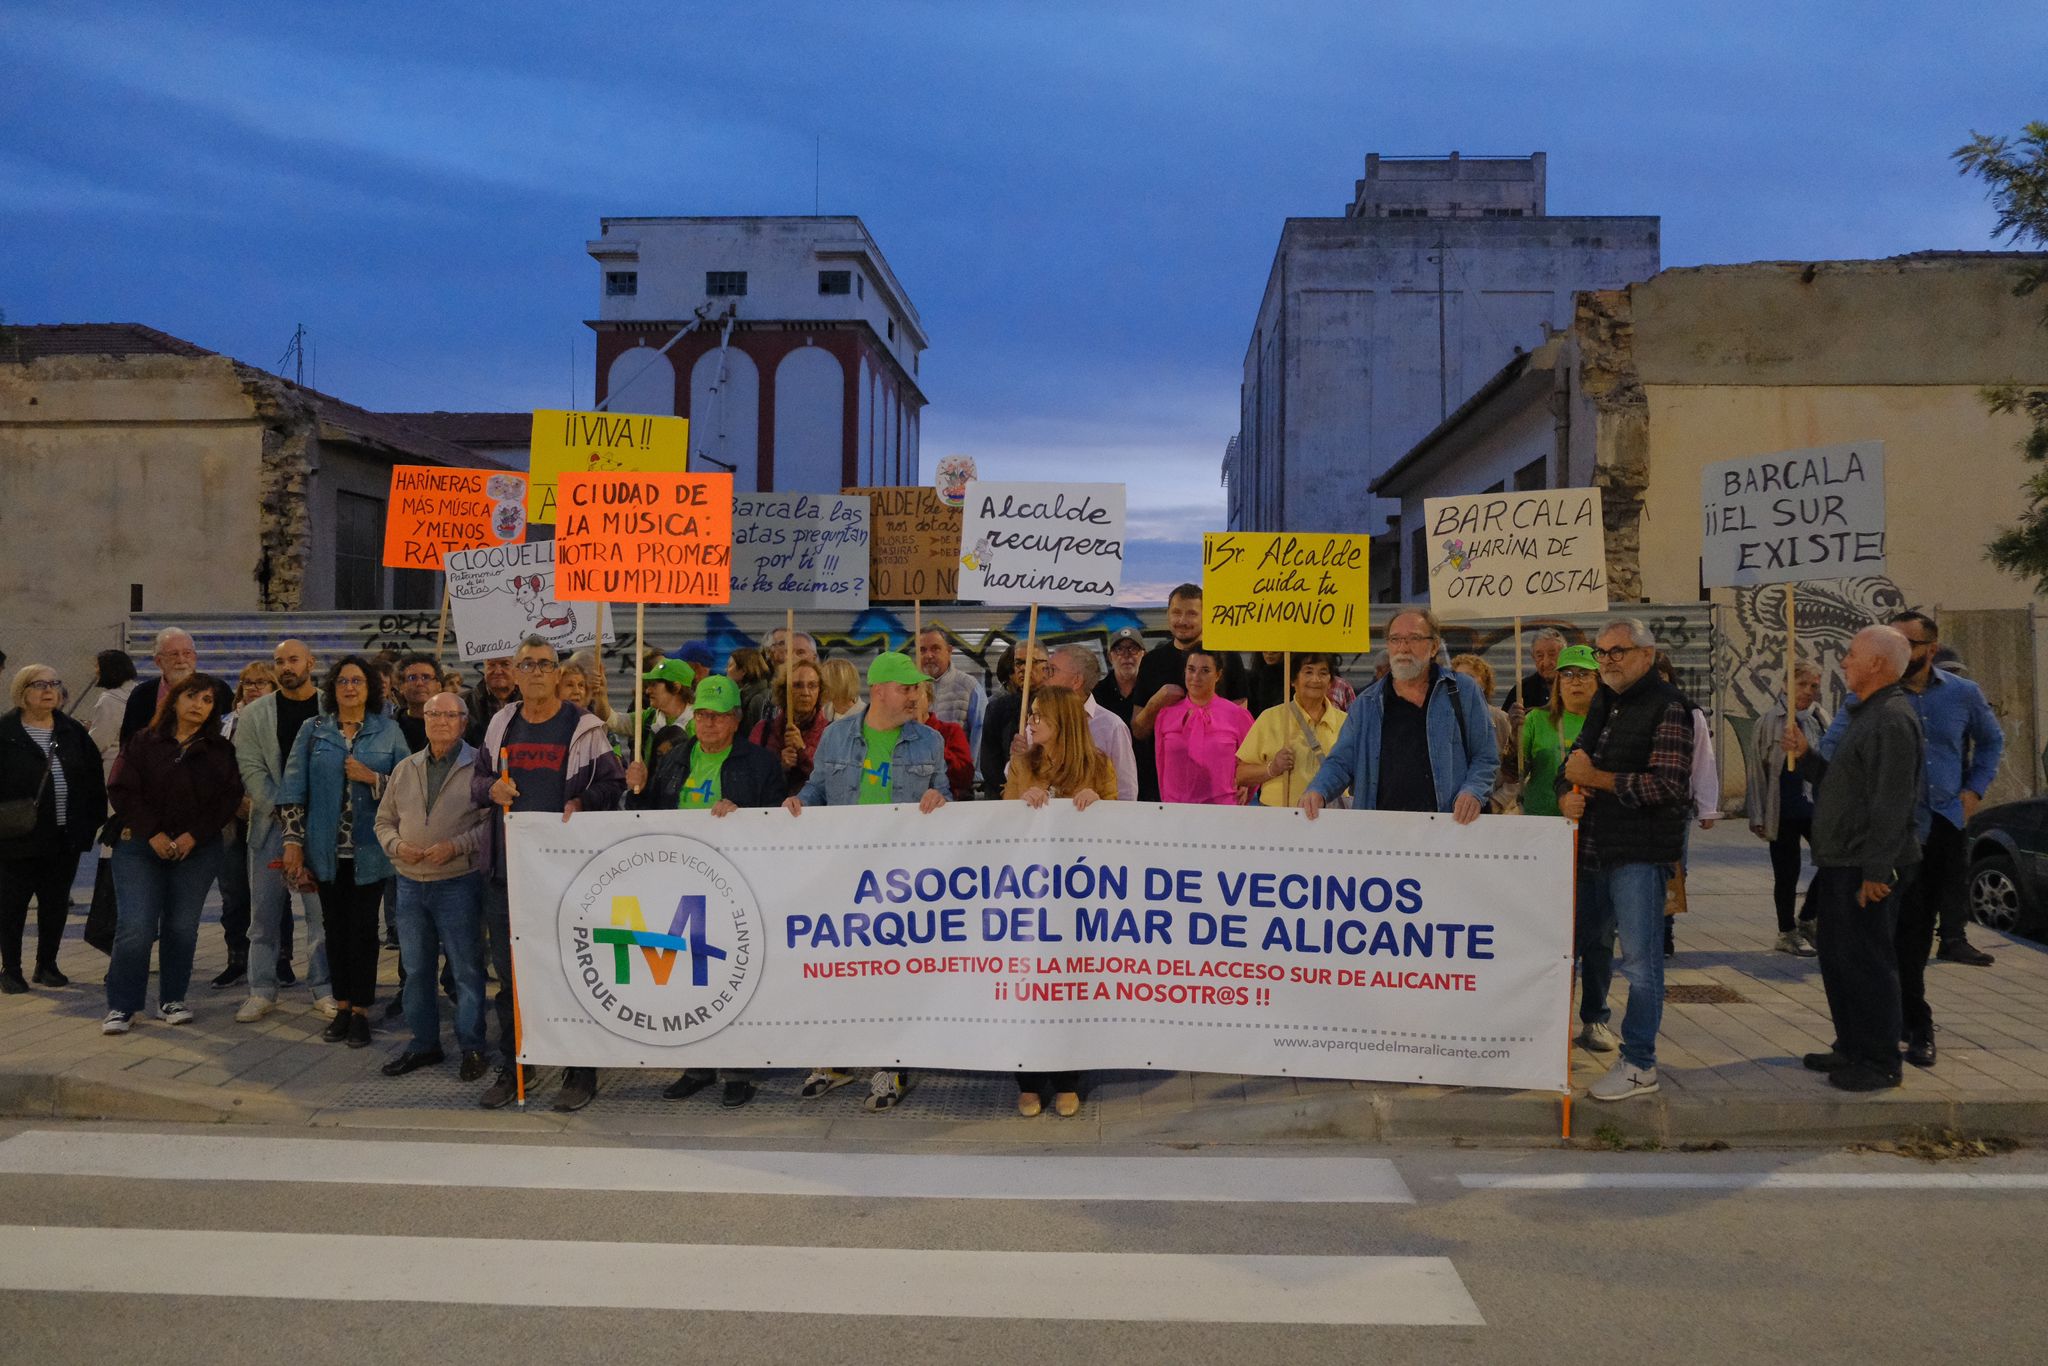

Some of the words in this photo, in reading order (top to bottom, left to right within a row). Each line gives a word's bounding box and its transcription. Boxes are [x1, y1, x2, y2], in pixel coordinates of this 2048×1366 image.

[1724, 451, 1865, 497] BARCALA
[438, 496, 491, 518] MÚSICA
[572, 482, 660, 507] CIUDAD
[675, 484, 708, 506] DE
[979, 493, 1112, 525] Alcalde
[566, 514, 590, 537] LA
[829, 500, 863, 524] las
[1432, 497, 1592, 537] BARCALA
[1772, 495, 1848, 527] SUR
[412, 520, 426, 536] Y
[427, 521, 485, 540] MENOS
[732, 522, 786, 545] atas
[792, 525, 869, 559] preguntan
[637, 543, 731, 567] PROMESA
[986, 530, 1123, 564] recupera
[1257, 536, 1361, 570] Alcalde
[1547, 536, 1578, 557] DE
[755, 553, 793, 577] por
[983, 562, 1115, 597] harineras
[456, 584, 490, 598] Ratas
[903, 569, 926, 596] LO
[1253, 569, 1312, 595] cuida
[1317, 570, 1339, 596] tu
[1447, 574, 1513, 599] OTRO
[1525, 568, 1608, 595] COSTAL
[465, 638, 517, 656] Barcala
[580, 851, 655, 913] ASOCIACIÓN
[658, 850, 678, 864] DE
[682, 852, 734, 898] VECINOS
[854, 856, 1128, 905] ASOCIACIÓN
[1144, 867, 1203, 904] DE
[1217, 870, 1424, 914] VECINOS
[786, 907, 968, 949] PARQUE
[981, 906, 1063, 943] DEL
[1075, 907, 1173, 945] MAR
[1188, 911, 1248, 949] DE
[1261, 915, 1496, 960] ALICANTE
[573, 925, 618, 1012] PARQUE
[617, 1005, 658, 1031] DEL
[662, 1005, 713, 1032] MAR
[712, 990, 733, 1012] DE
[732, 908, 750, 991] ALICANTE
[802, 958, 901, 979] NUESTRO
[905, 956, 1004, 975] OBJETIVO
[1007, 957, 1032, 974] ES
[1036, 957, 1062, 976] LA
[1065, 956, 1152, 976] MEJORA
[1156, 959, 1201, 977] DEL
[1200, 960, 1285, 982] ACCESO
[1289, 966, 1332, 986] SUR
[1337, 969, 1367, 987] DE
[1369, 971, 1477, 992] ALICANTE
[1014, 977, 1089, 1002] ÚNETE
[1092, 982, 1111, 1001] A
[1116, 982, 1249, 1005] NOSOTR@S
[1273, 1035, 1511, 1060] www.avparquedelmaralicante.com
